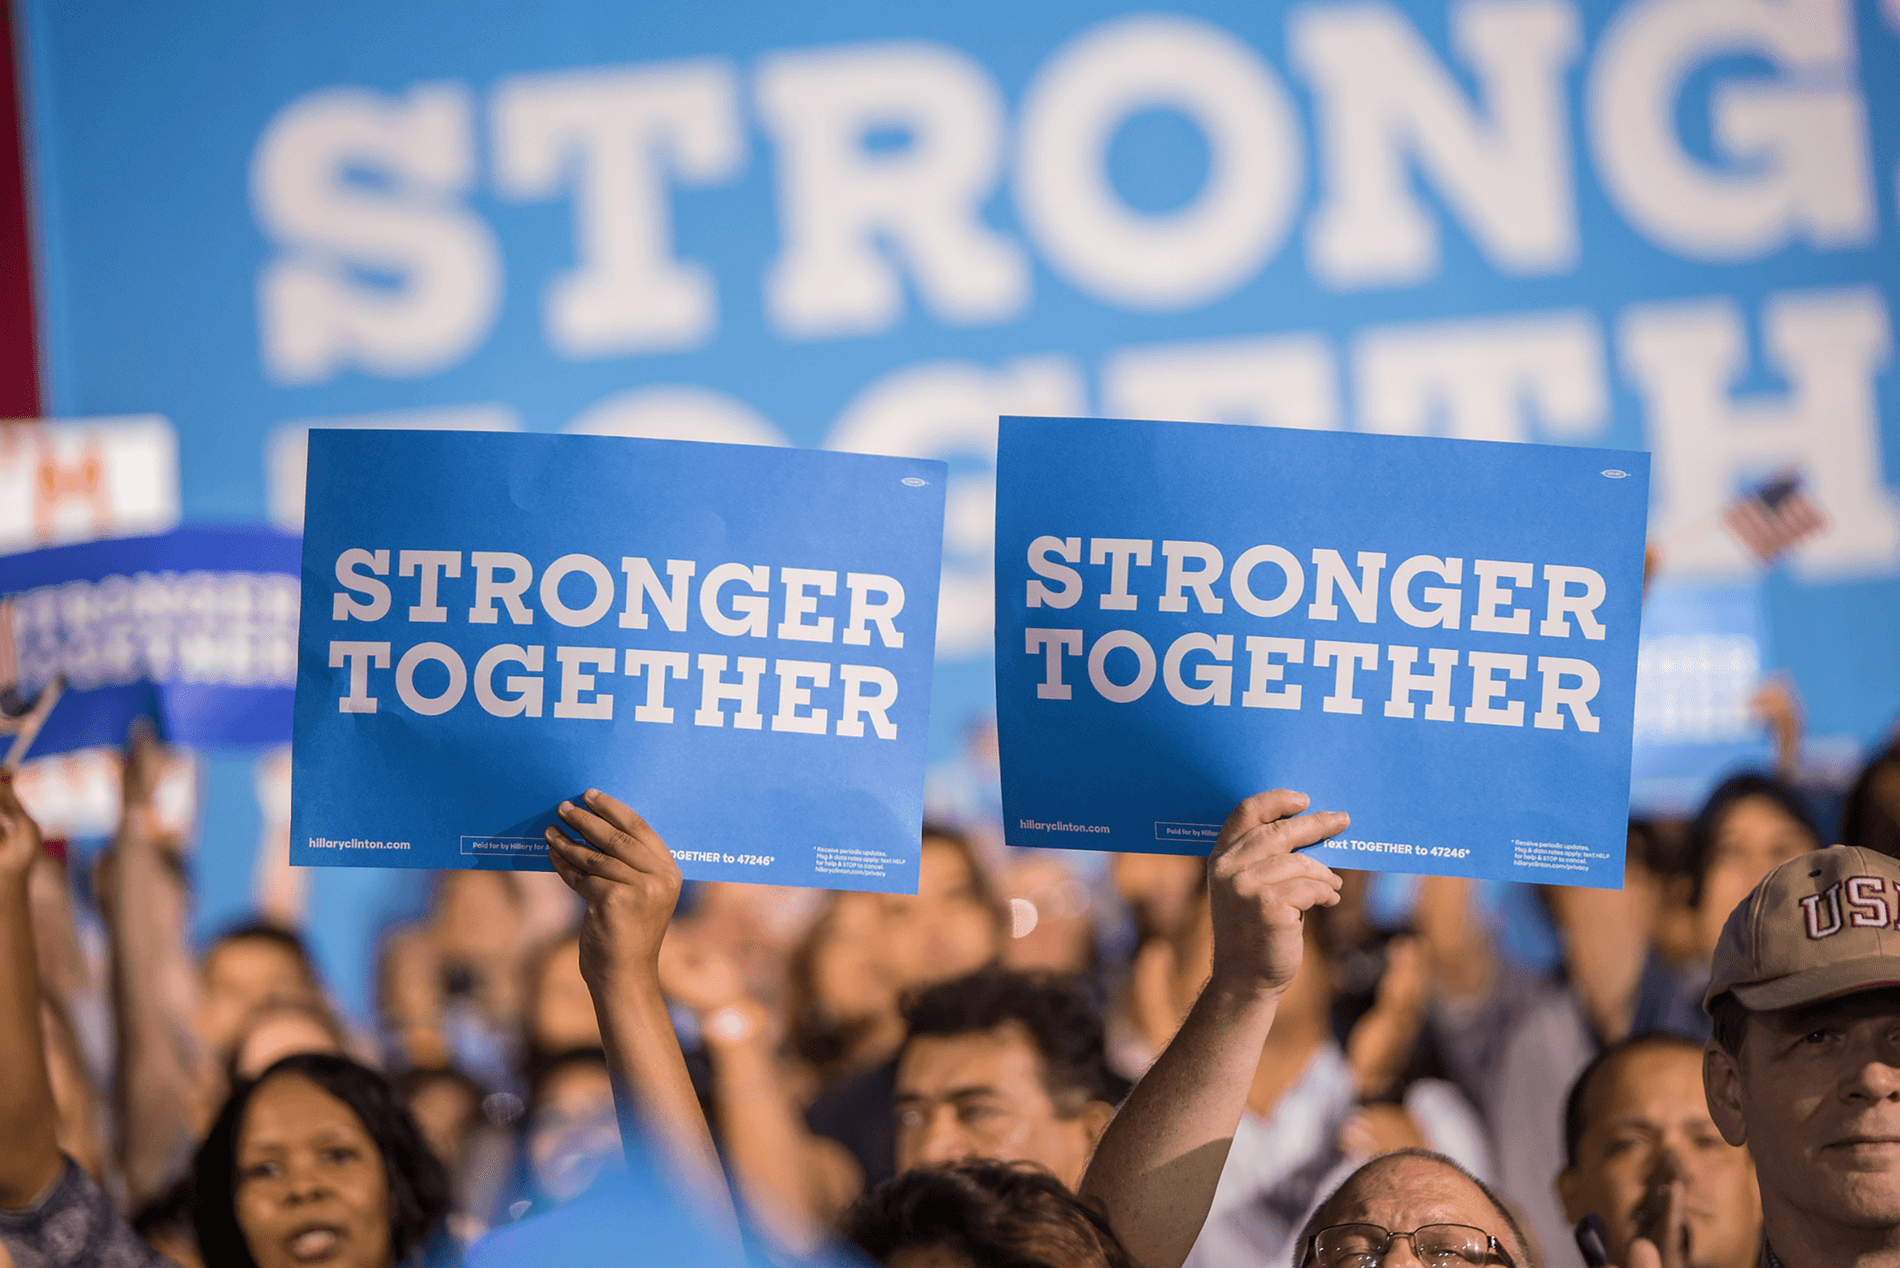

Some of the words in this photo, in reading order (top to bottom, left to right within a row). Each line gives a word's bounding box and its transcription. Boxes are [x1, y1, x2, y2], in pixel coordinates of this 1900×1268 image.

[254, 0, 1900, 381] STRONG
[332, 548, 906, 649] STRONGER
[1026, 536, 1607, 641] STRONGER
[328, 640, 899, 741] TOGETHER
[1025, 627, 1601, 733] TOGETHER
[308, 838, 411, 850] hillaryclinton.com
[500, 842, 509, 850] by
[670, 850, 720, 862] OGETHER
[723, 853, 735, 864] to
[1020, 819, 1110, 834] hillaryclinton.com
[1350, 840, 1412, 854] TOGETHER
[1415, 845, 1428, 856] to
[1799, 876, 1900, 940] US
